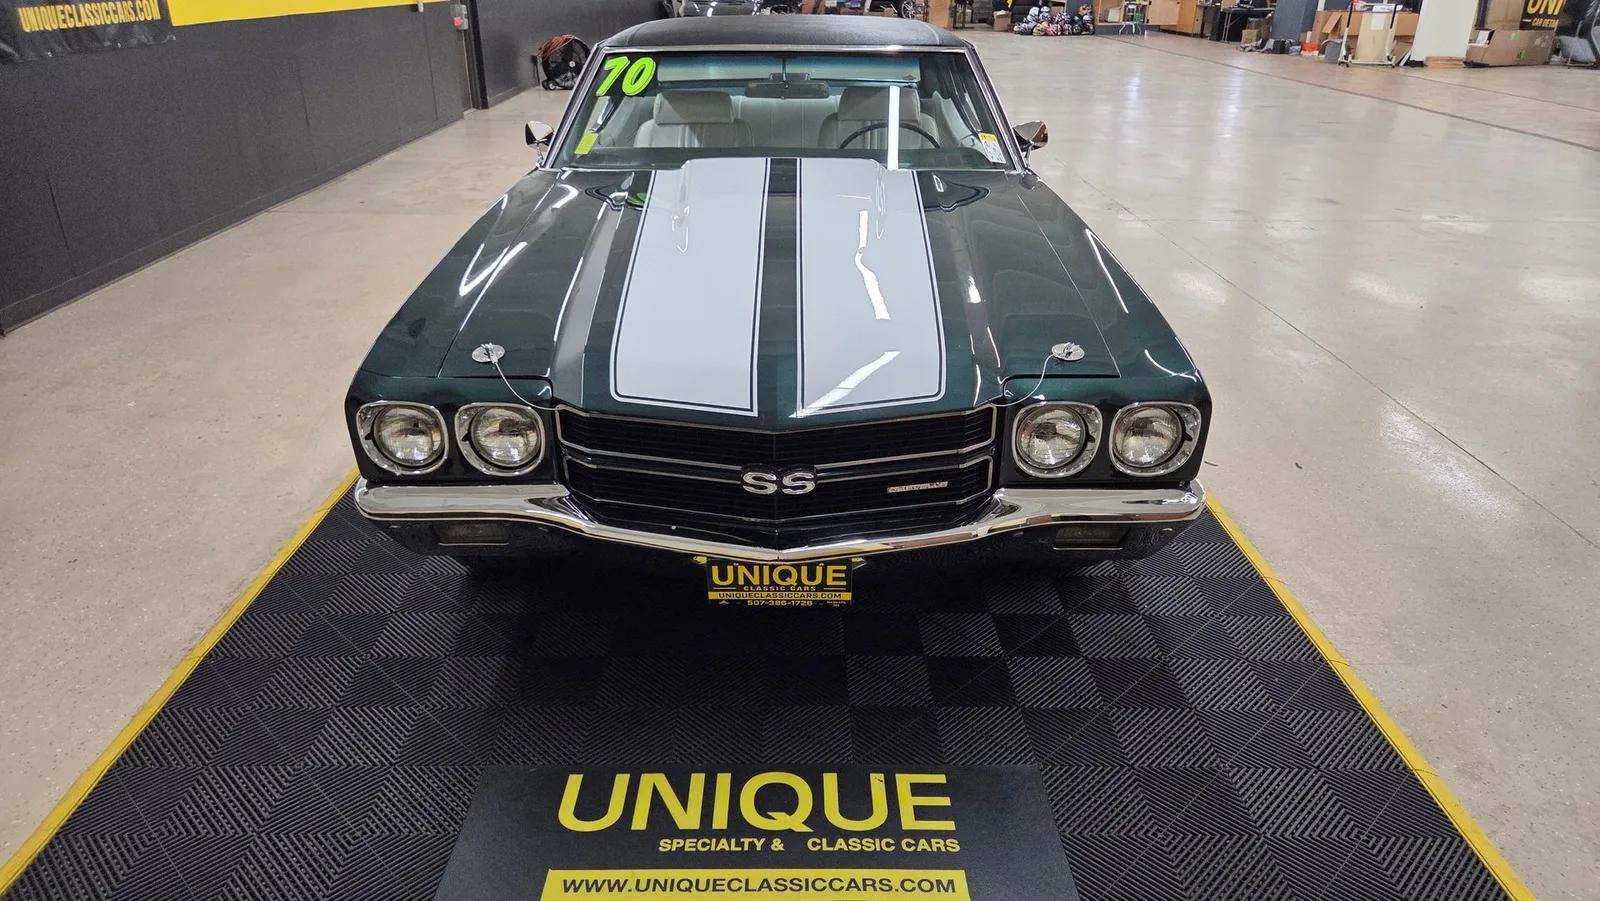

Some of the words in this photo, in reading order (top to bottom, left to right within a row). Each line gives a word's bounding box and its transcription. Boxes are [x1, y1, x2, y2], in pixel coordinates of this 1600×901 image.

[18, 0, 160, 32] UNIQUECLASSICCARS.COM
[596, 56, 656, 96] 70
[742, 471, 816, 495] SS
[711, 565, 847, 586] UNIQUE
[558, 771, 956, 832] UNIQUE
[658, 838, 765, 852] SPECIALTY
[770, 838, 785, 851] &
[807, 838, 896, 851] CLASSIC
[901, 838, 961, 853] CARS
[562, 878, 957, 893] WWW.UNIQUECLASSICCARS.COM
